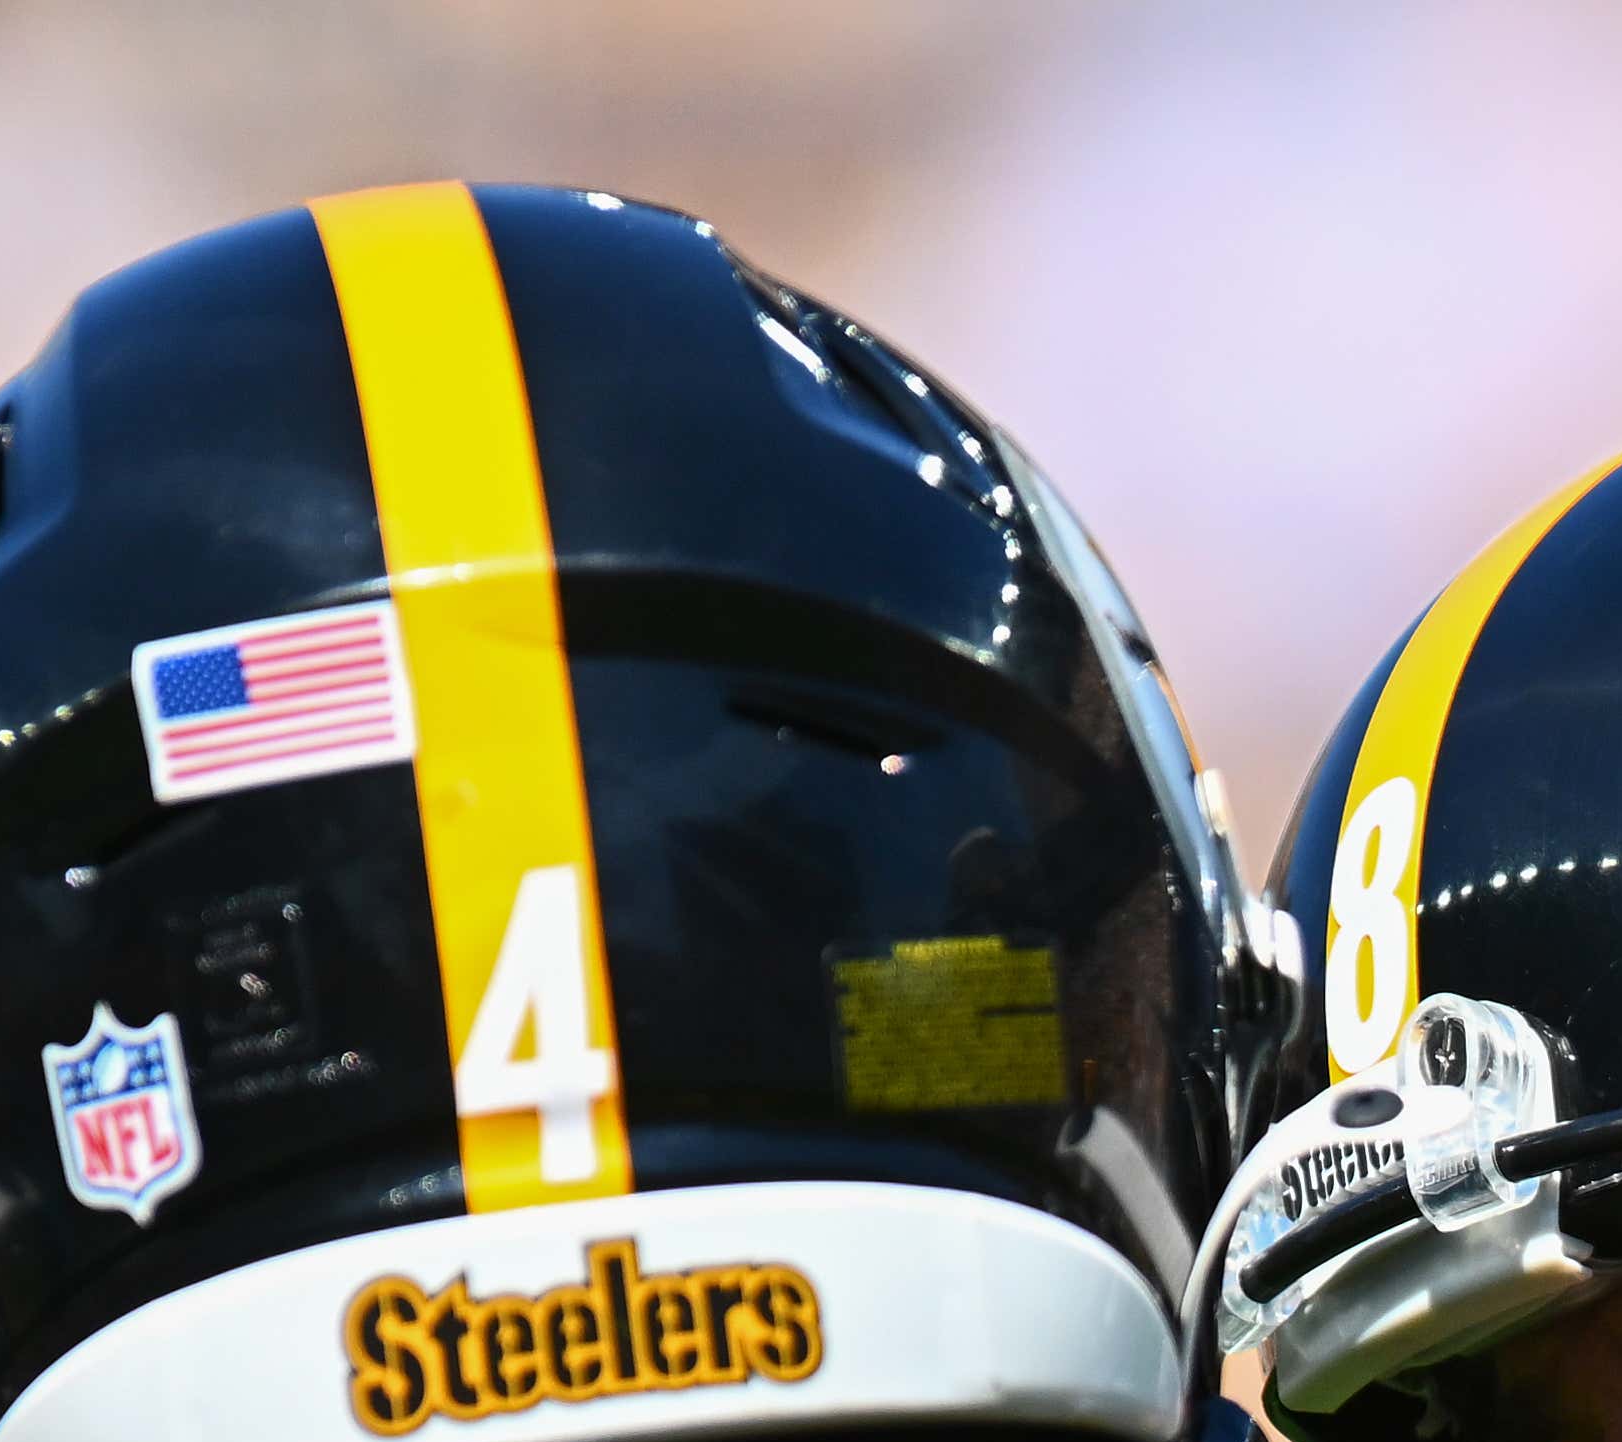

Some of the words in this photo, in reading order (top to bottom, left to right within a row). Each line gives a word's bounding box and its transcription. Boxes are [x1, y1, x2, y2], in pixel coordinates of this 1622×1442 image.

[457, 862, 613, 1183] 4
[1325, 776, 1418, 1074] 8
[73, 1095, 182, 1181] NFL
[343, 1236, 824, 1436] Steelers
